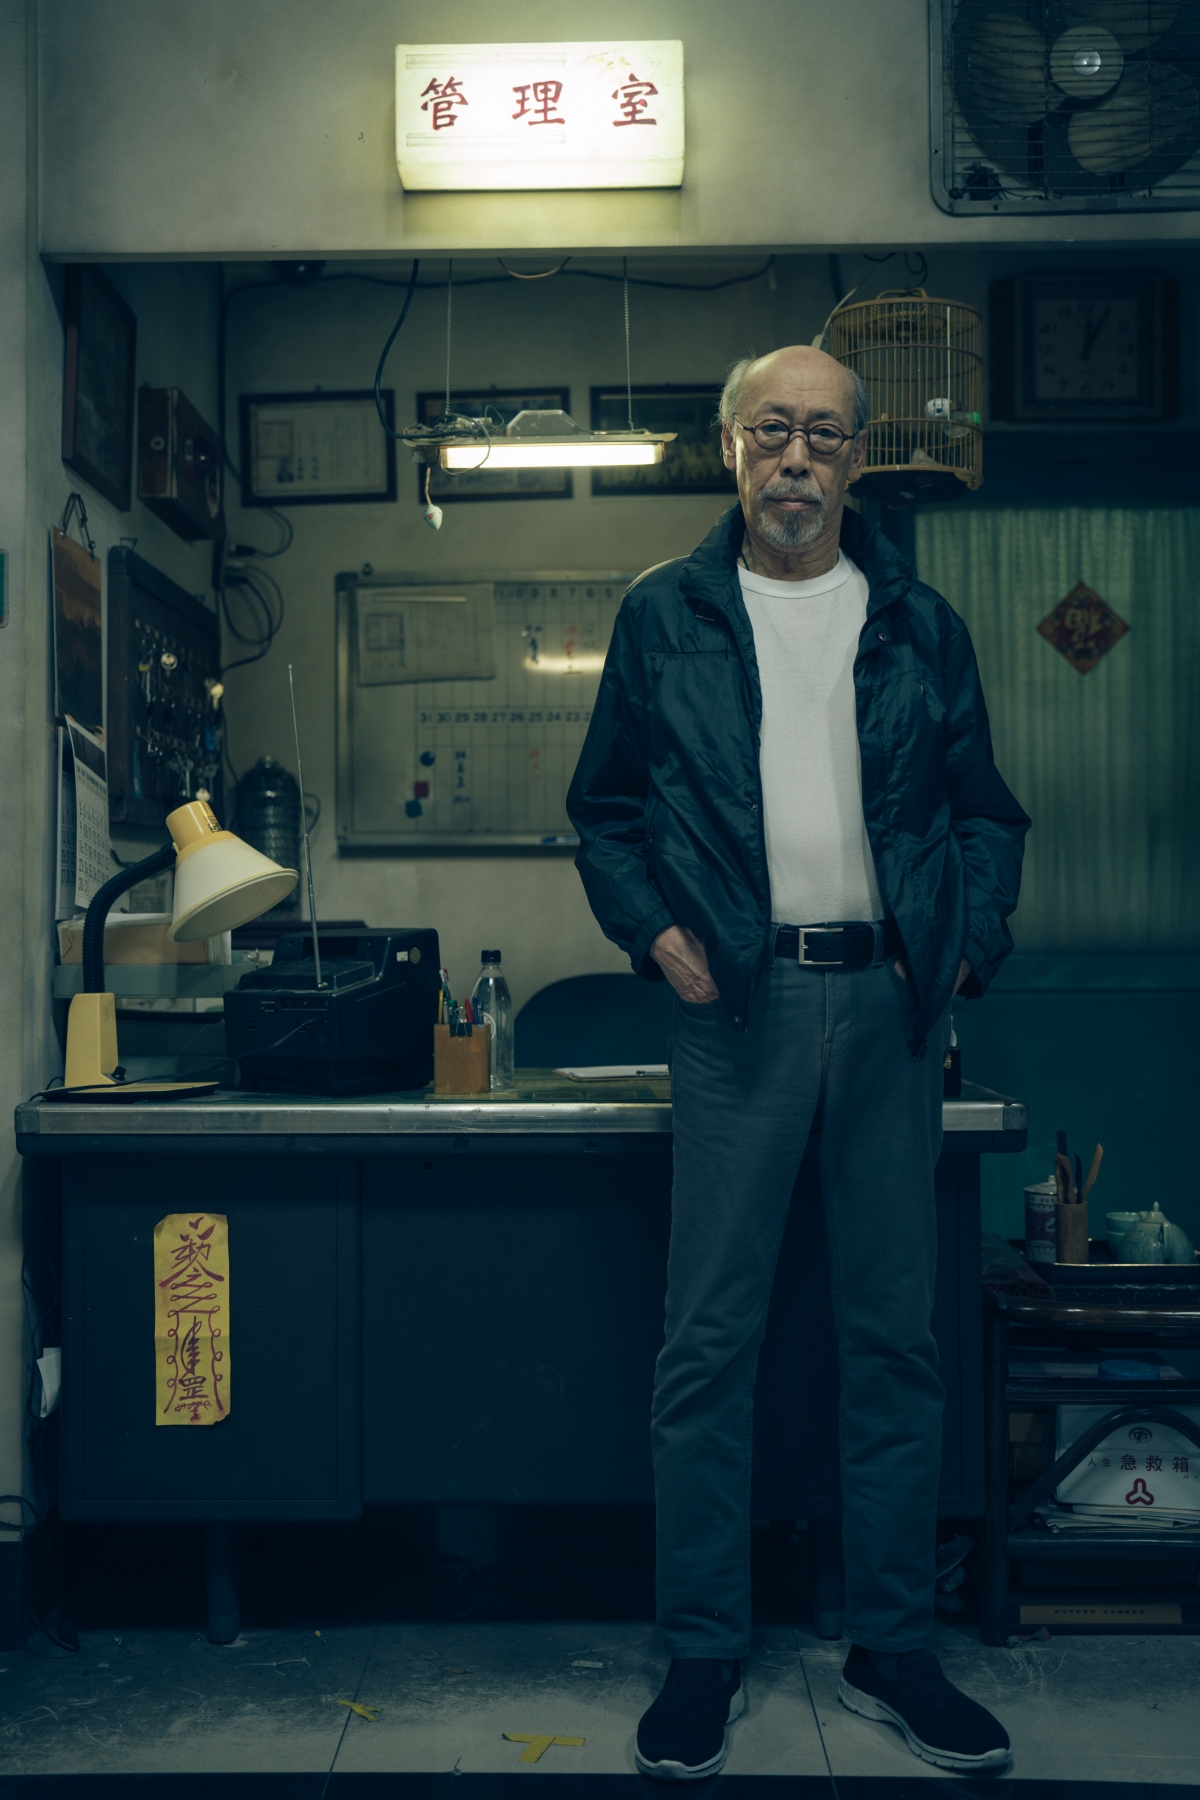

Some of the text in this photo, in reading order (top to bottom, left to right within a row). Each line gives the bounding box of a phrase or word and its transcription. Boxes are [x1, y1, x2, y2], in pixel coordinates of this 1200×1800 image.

[420, 73, 658, 131] 管理室
[455, 711, 470, 724] 29
[474, 711, 488, 724] 28
[492, 711, 507, 724] 27
[510, 711, 525, 724] 26
[529, 711, 543, 724] 25
[547, 711, 561, 724] 24
[565, 711, 581, 724] 23
